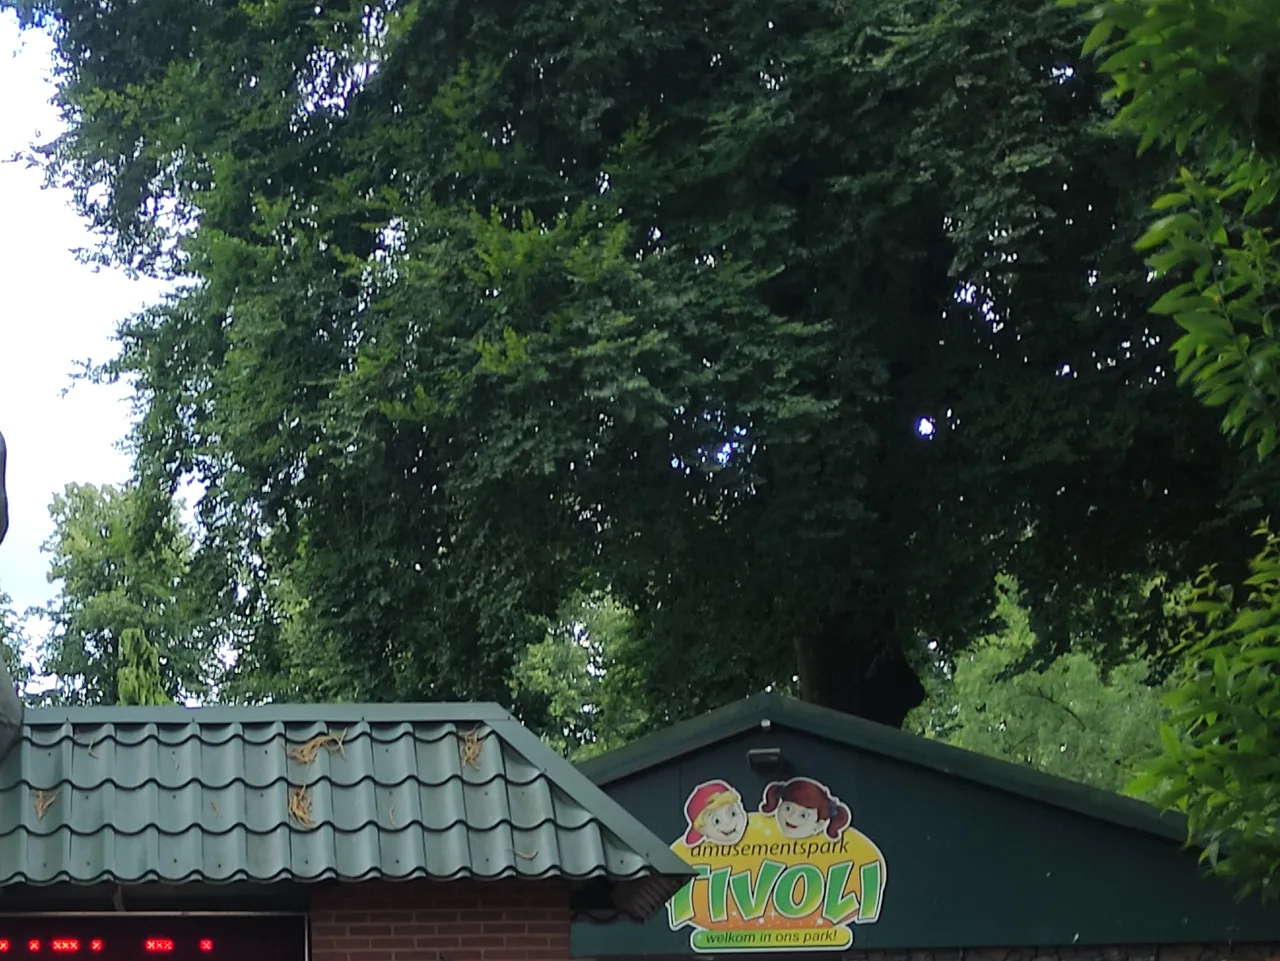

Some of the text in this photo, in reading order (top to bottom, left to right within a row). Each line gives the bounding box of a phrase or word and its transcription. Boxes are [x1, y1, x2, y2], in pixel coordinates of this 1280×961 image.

[690, 839, 850, 859] amusementspark
[671, 858, 882, 928] TIVOLI
[706, 929, 838, 945] welkom in ons park!
